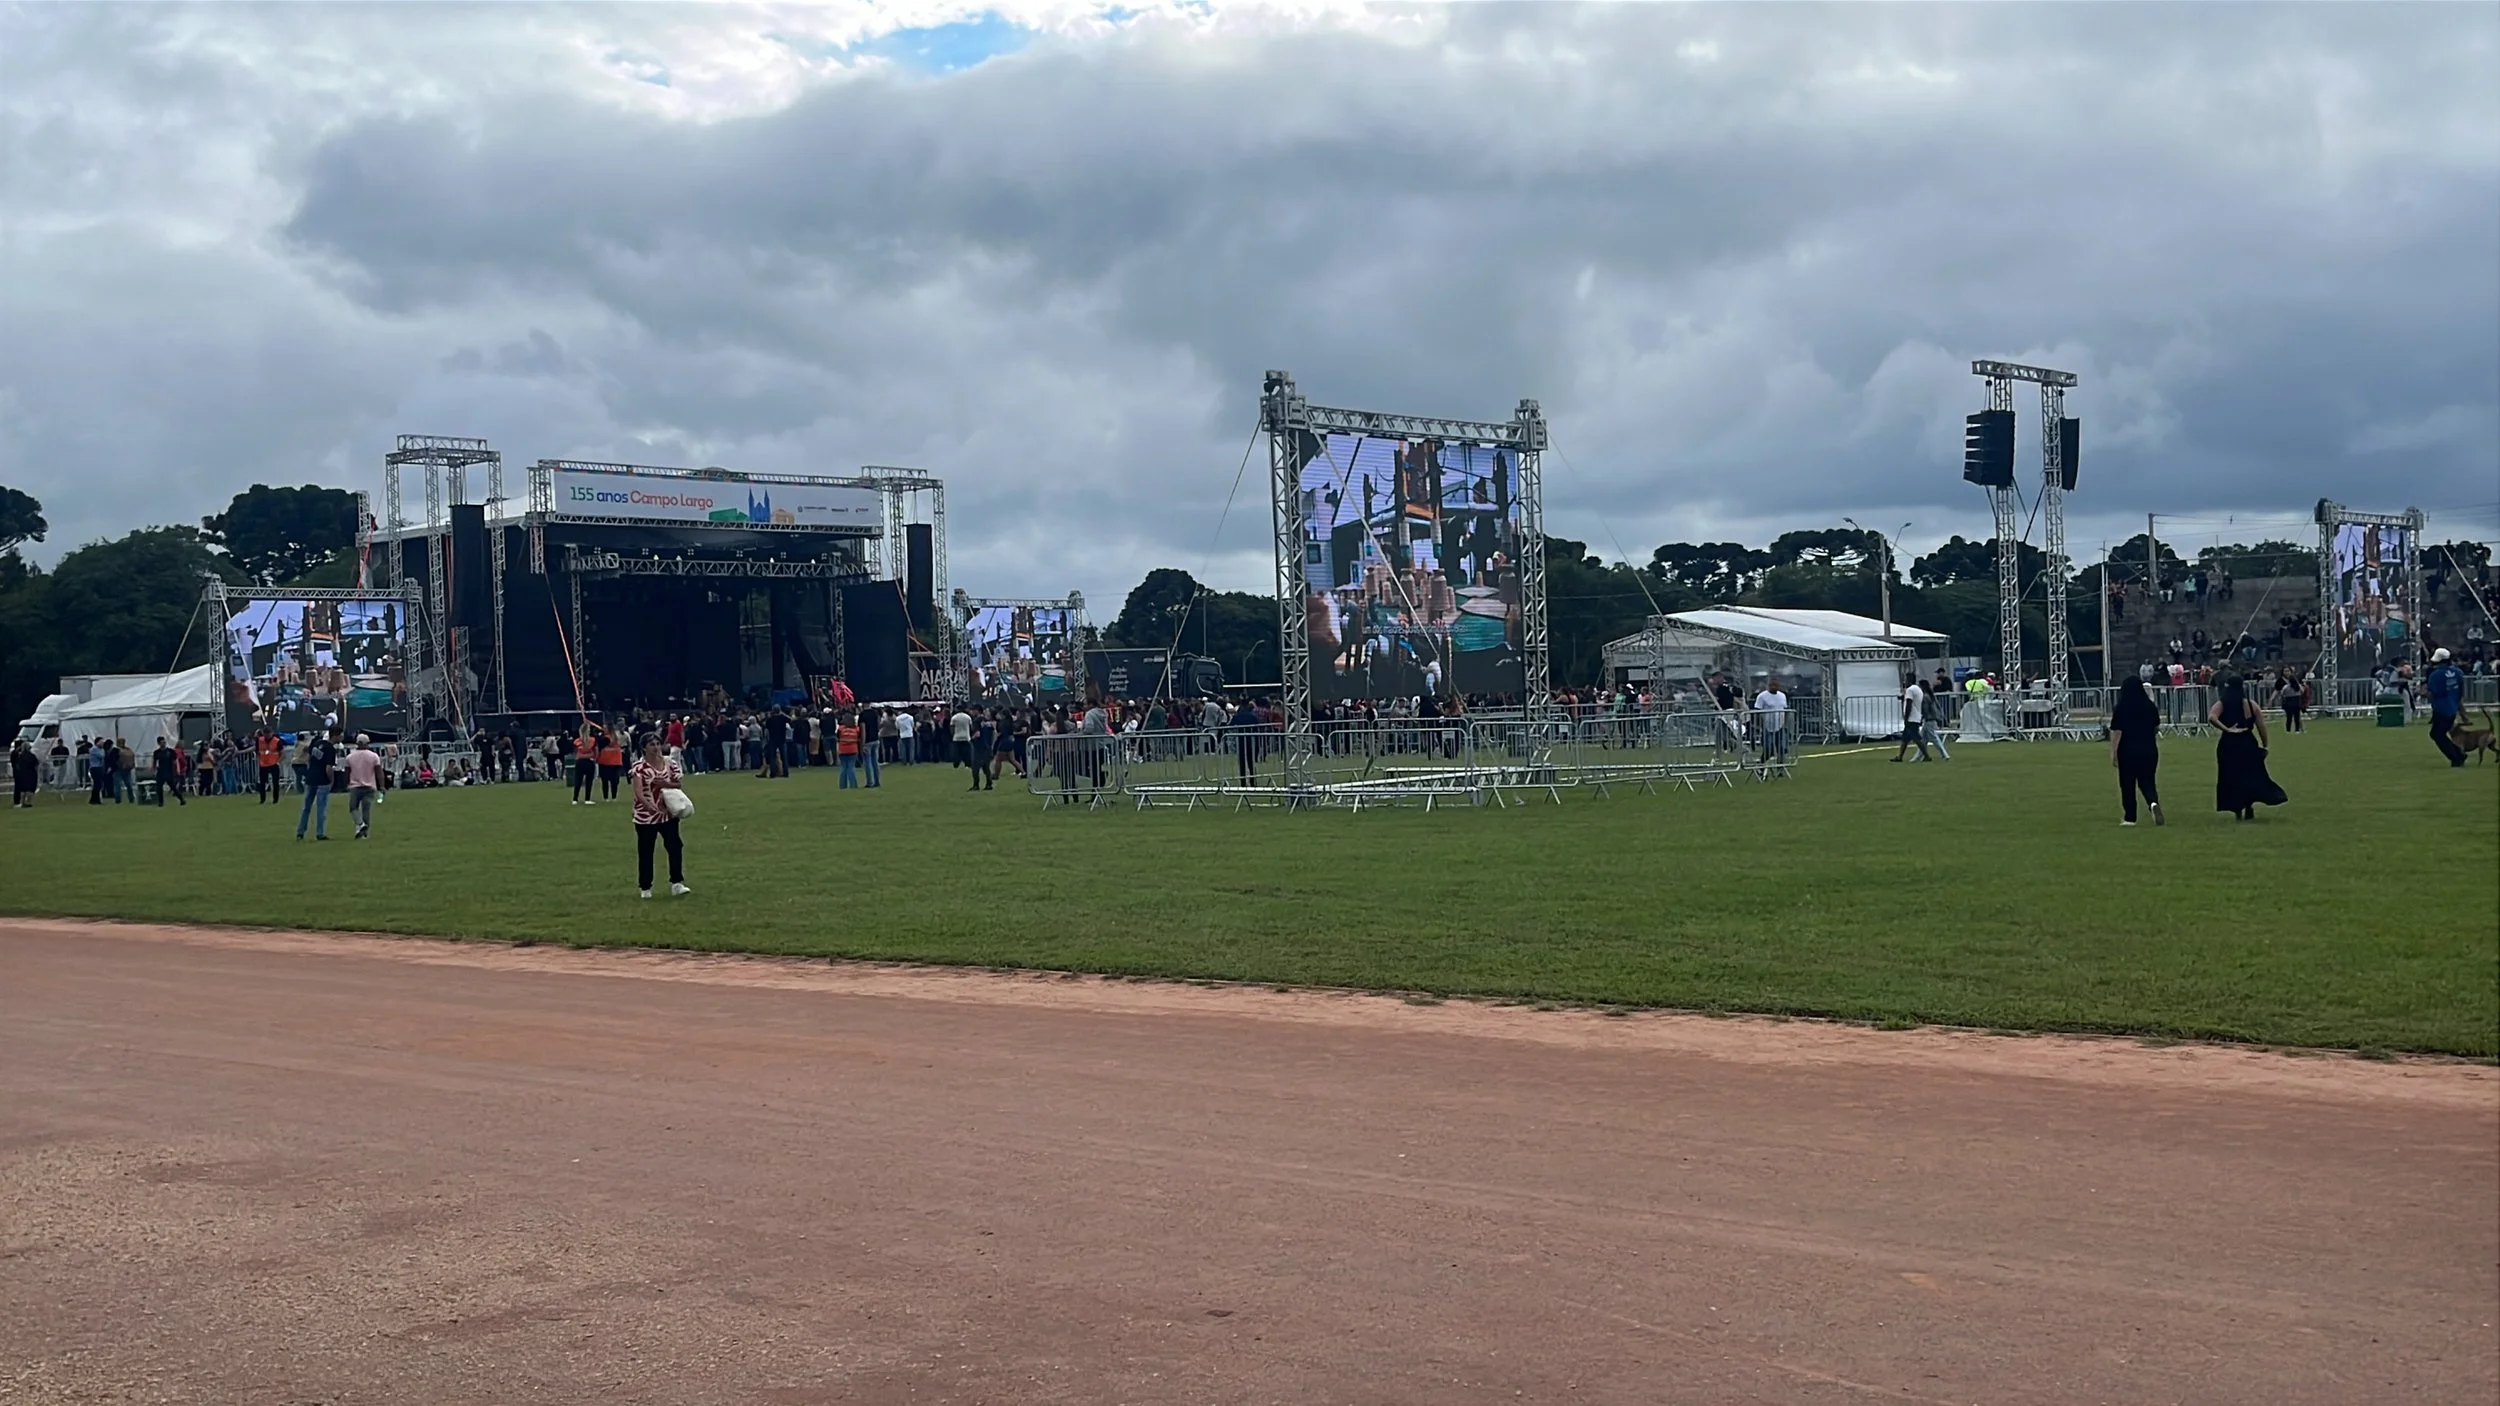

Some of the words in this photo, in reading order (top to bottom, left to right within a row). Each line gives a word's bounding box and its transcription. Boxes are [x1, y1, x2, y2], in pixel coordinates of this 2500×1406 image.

[570, 486, 594, 501] 155
[596, 490, 628, 503] anos
[630, 490, 678, 508] Campo
[680, 493, 714, 510] Largo
